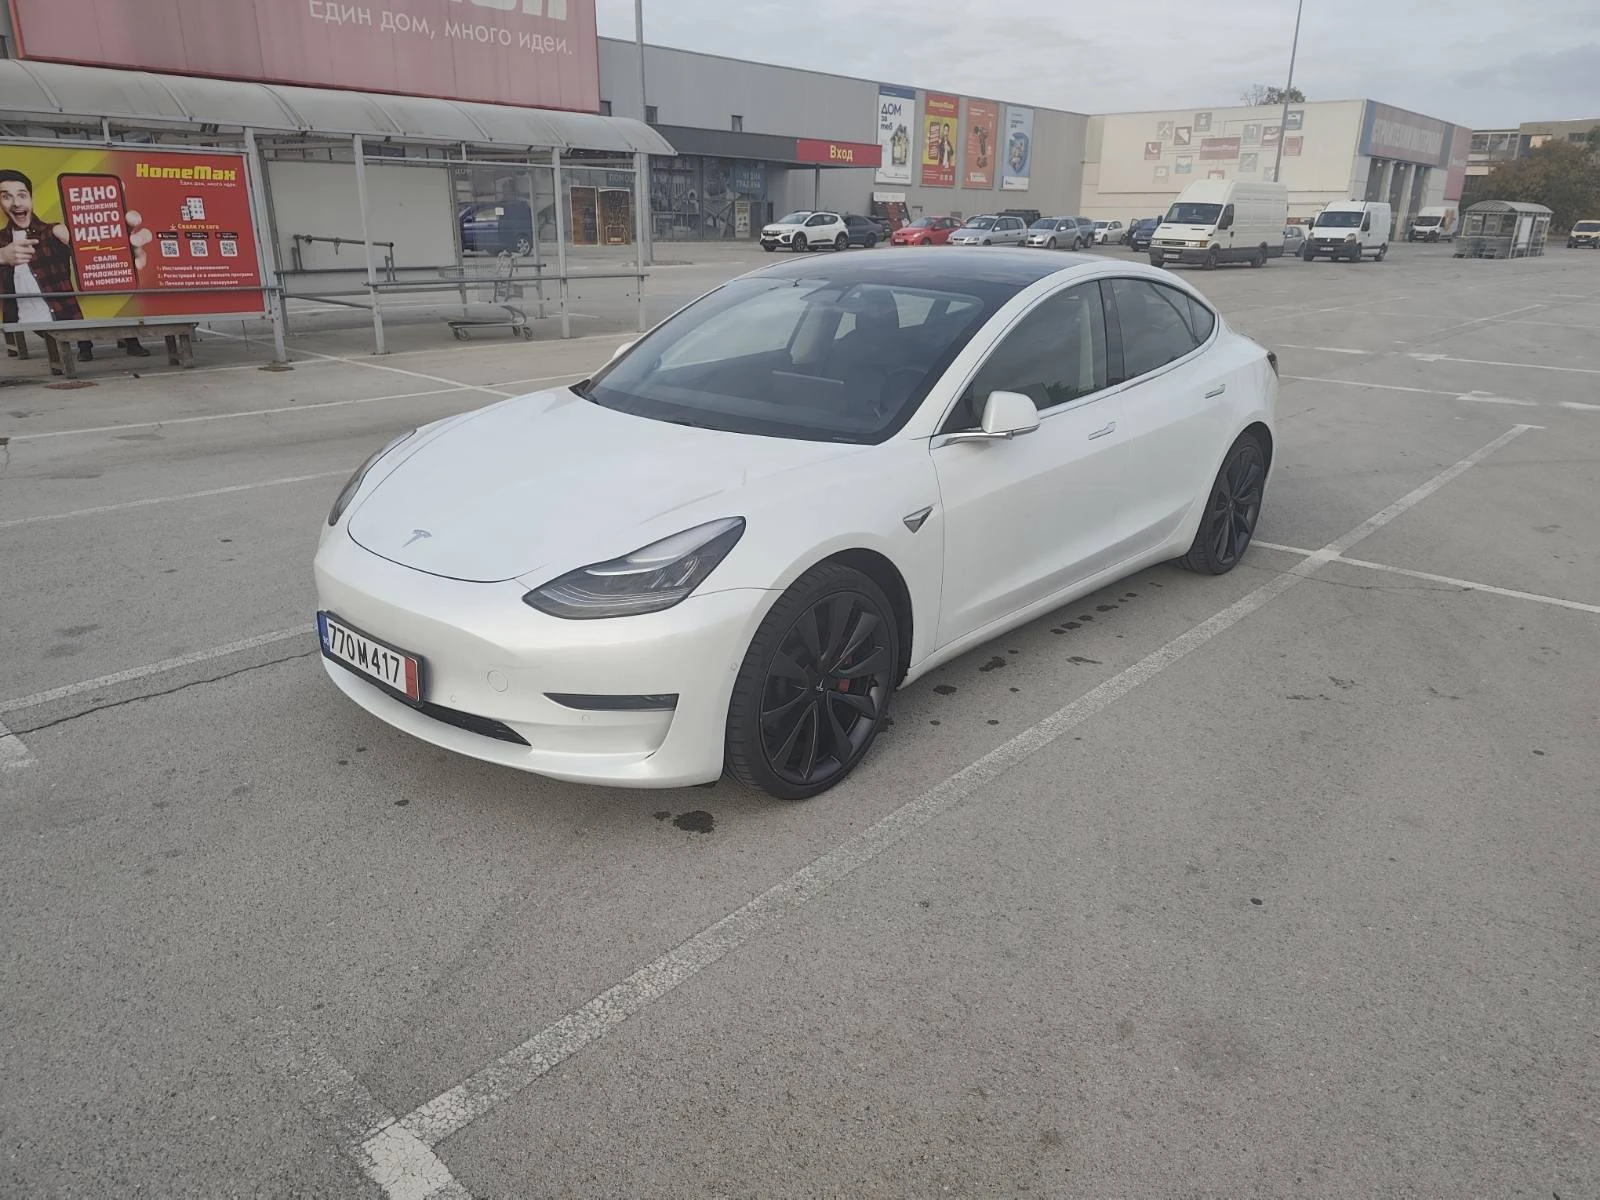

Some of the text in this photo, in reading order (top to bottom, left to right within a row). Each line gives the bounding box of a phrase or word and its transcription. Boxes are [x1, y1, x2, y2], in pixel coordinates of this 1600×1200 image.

[308, 0, 372, 26] Един
[381, 10, 436, 40] дом,
[444, 22, 512, 46] много
[519, 34, 573, 55] идеи.
[881, 103, 902, 116] ДОМ
[829, 144, 853, 162] Вход
[136, 163, 236, 181] HomeMax
[69, 185, 117, 204] ЕДНО
[72, 202, 118, 211] ПРИЛОЖЕНИЕ
[72, 211, 120, 225] МНОГО
[74, 224, 122, 242] ИДЕИ
[85, 261, 128, 270] МОБИЛНОТО
[83, 269, 132, 279] ПРИЛОЖЕНИЕ
